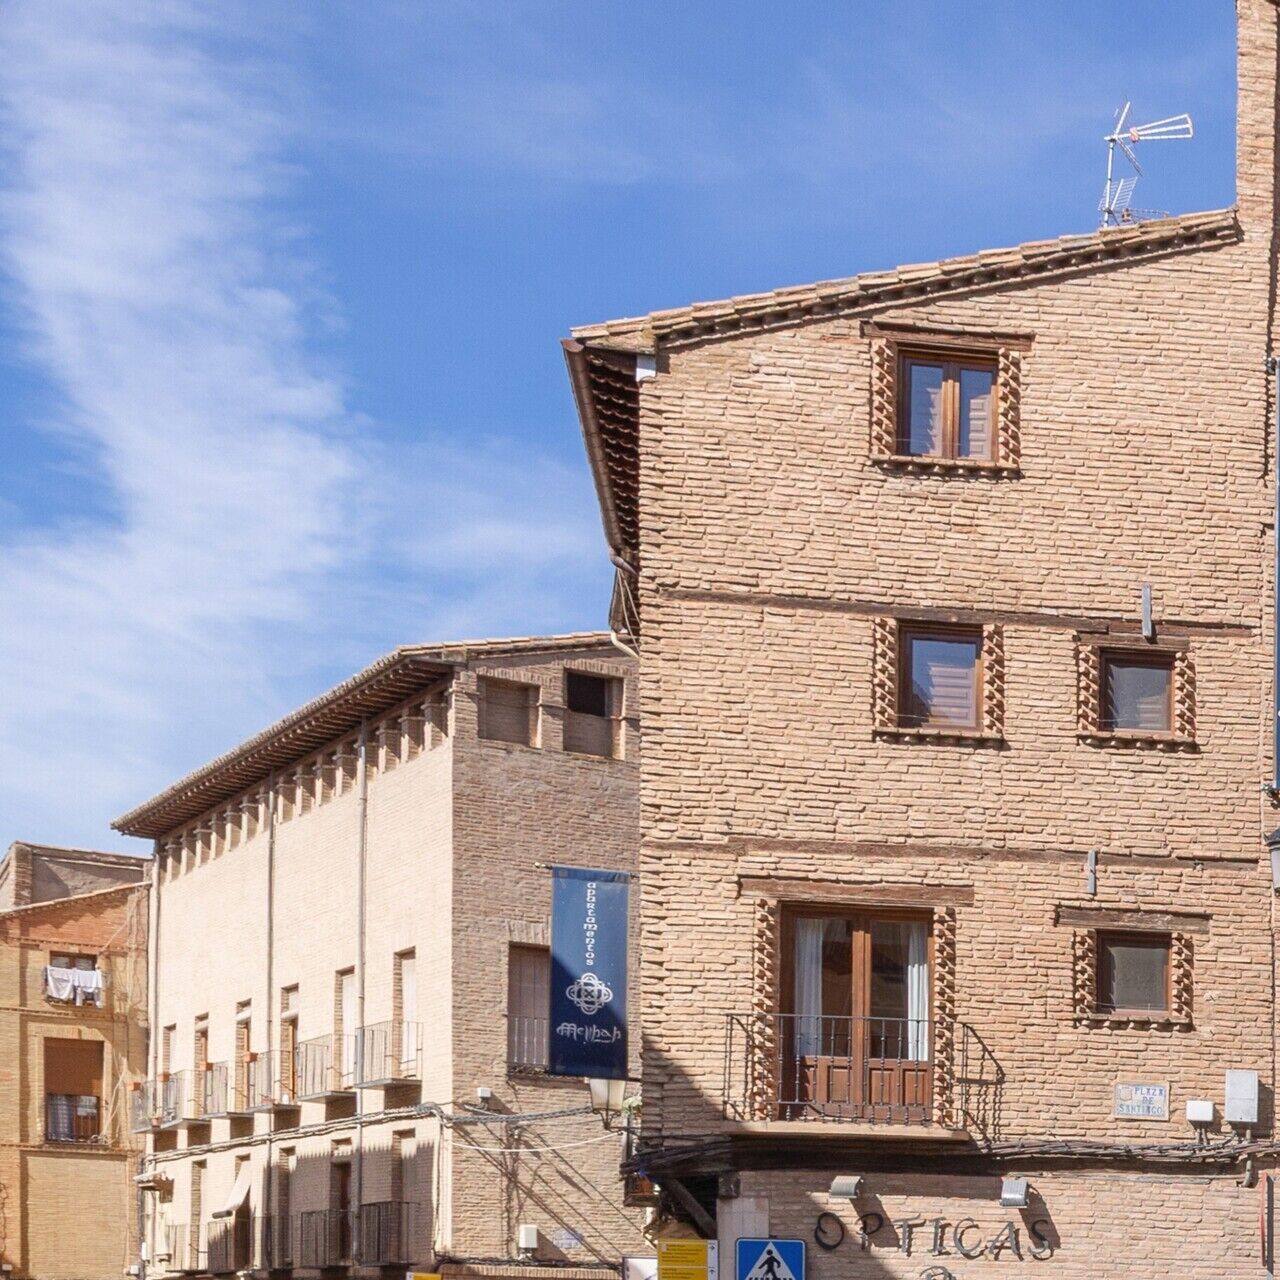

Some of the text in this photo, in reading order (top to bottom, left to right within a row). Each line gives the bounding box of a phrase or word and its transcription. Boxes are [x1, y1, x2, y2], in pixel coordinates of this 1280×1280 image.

[583, 881, 598, 966] apartamentos
[1134, 1086, 1164, 1096] PLAZA
[1142, 1096, 1154, 1105] DE
[1119, 1103, 1163, 1114] SANTIAGO
[814, 1211, 1052, 1258] OPTICAS
